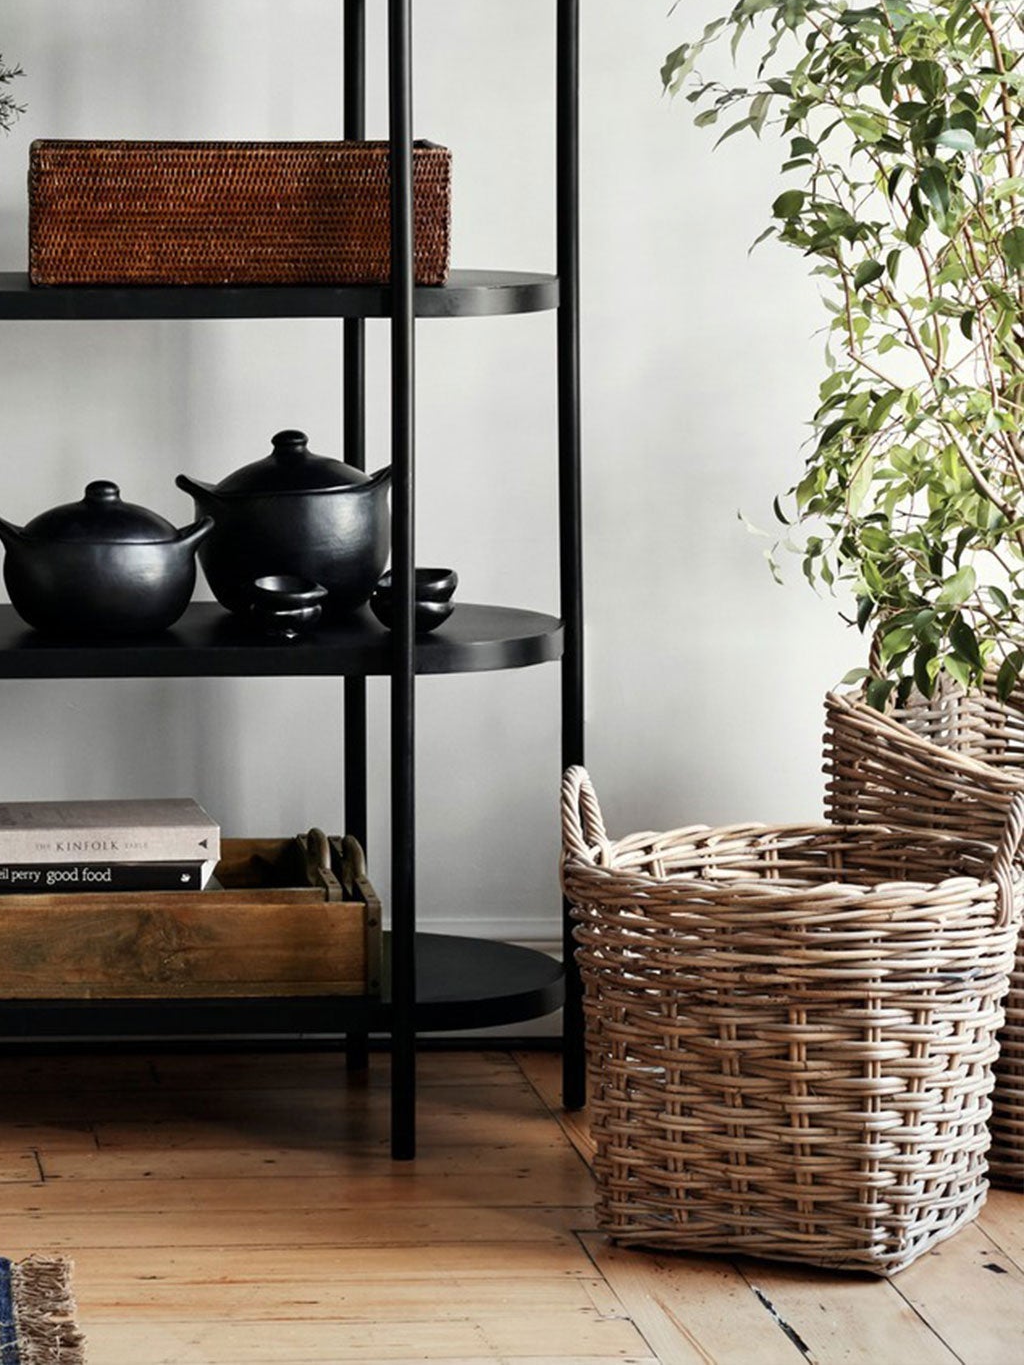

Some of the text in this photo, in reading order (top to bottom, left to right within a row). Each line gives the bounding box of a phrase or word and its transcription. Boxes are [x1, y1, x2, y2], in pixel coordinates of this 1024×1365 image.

[56, 840, 119, 852] KINFOLK
[11, 870, 41, 883] perry
[46, 867, 79, 885] good
[82, 867, 112, 882] food
